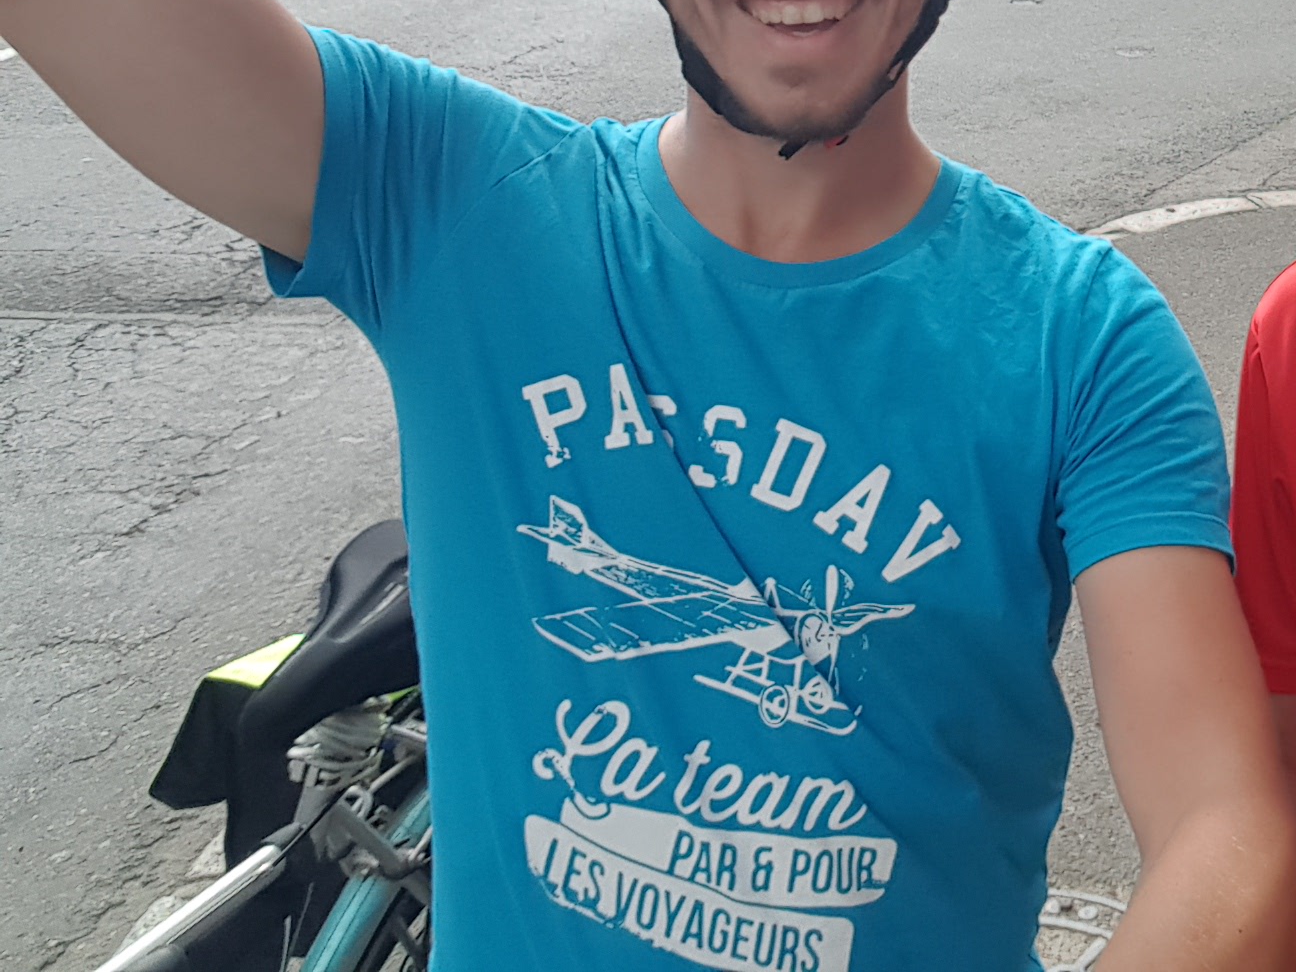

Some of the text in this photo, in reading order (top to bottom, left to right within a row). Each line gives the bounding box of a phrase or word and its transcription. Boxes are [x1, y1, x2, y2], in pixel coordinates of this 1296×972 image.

[532, 699, 868, 832] La team
[543, 837, 824, 972] LES VOYAGEURS
[667, 828, 880, 895] PAR & POUR
